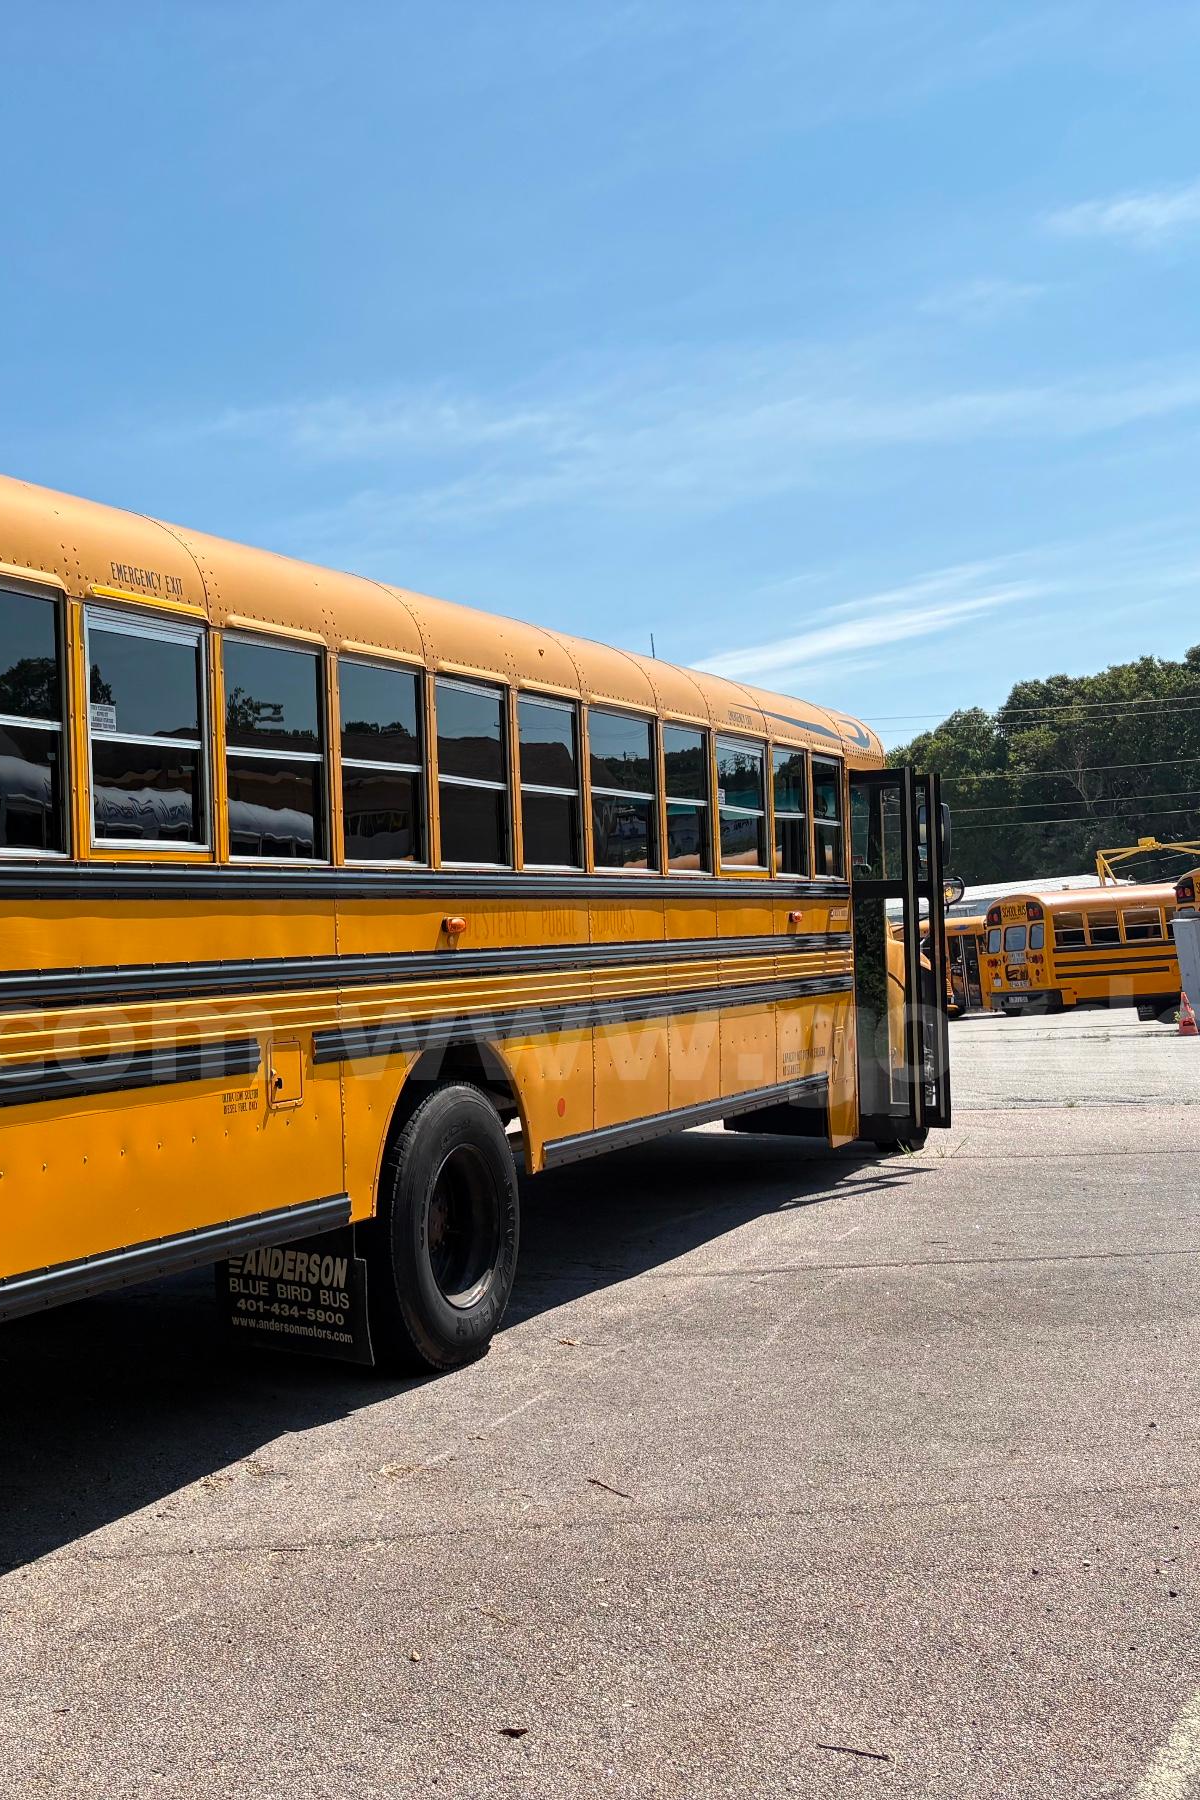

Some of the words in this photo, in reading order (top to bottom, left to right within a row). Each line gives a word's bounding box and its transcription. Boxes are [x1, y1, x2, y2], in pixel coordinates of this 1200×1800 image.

[110, 562, 162, 591] EMERGENCY
[165, 575, 183, 595] EXIT
[243, 1247, 348, 1289] ANDERSON
[229, 1277, 269, 1297] BLUE
[276, 1283, 312, 1303] BIRD
[320, 1289, 350, 1309] BUS
[236, 1298, 345, 1326] 401-434-5900
[231, 1315, 353, 1344] www.andersonmotors.com
